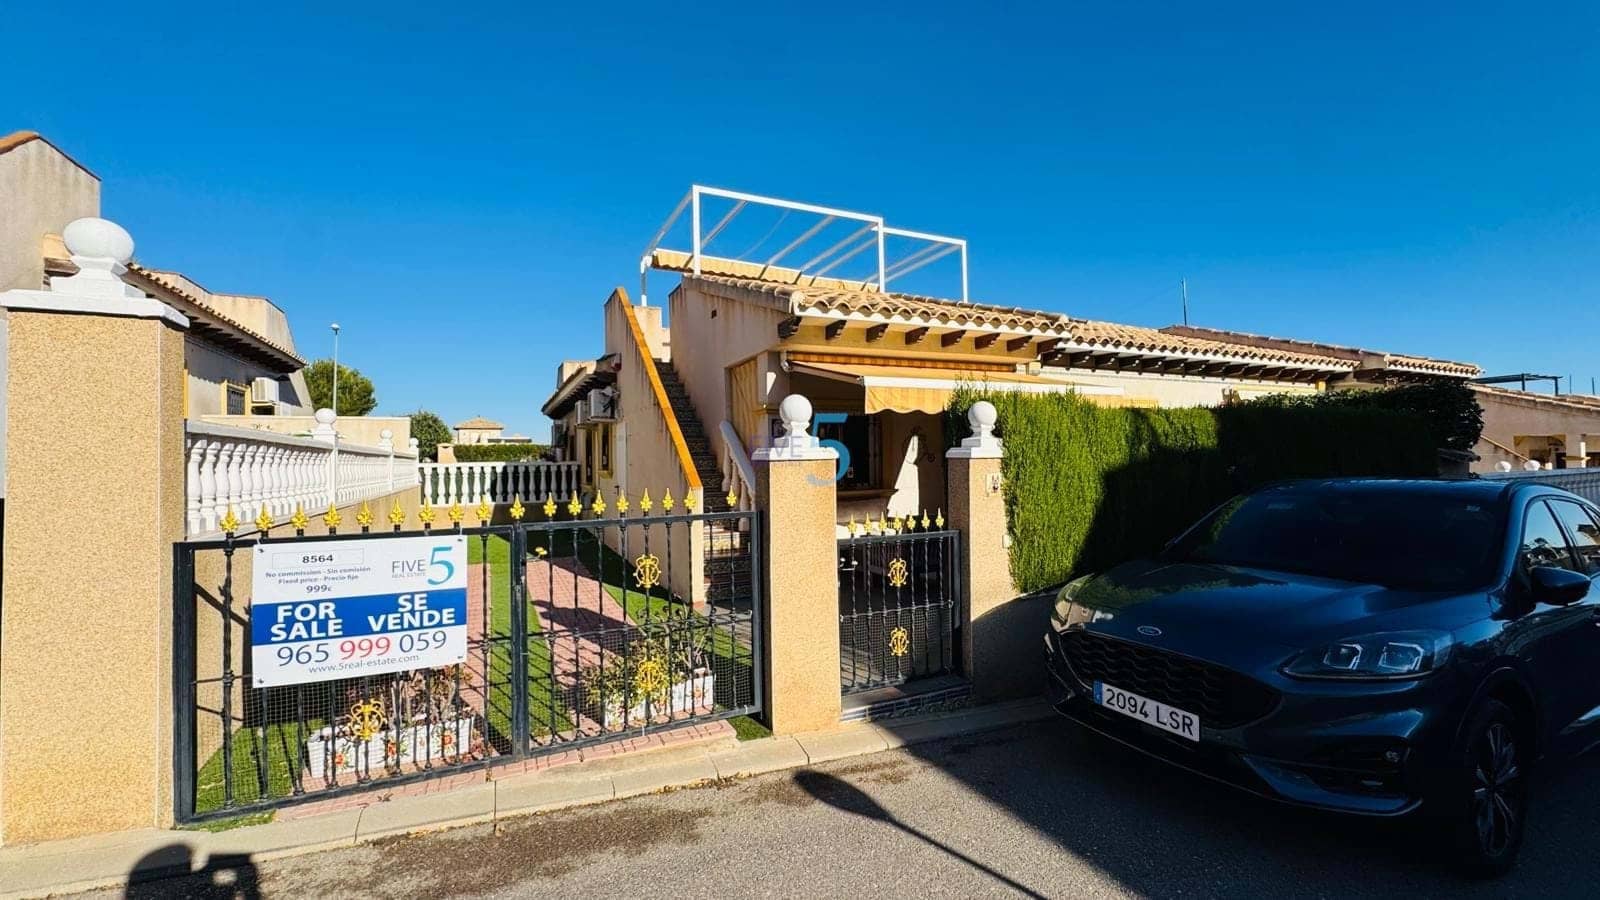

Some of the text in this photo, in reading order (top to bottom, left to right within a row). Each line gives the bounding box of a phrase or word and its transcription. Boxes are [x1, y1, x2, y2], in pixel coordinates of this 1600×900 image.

[302, 554, 334, 564] 8564
[391, 546, 455, 586] FIVE 5
[277, 602, 336, 624] FOR
[397, 593, 429, 613] SE
[270, 618, 344, 642] SALE
[367, 608, 456, 633] VENDE
[277, 630, 447, 667] 965 999 059
[308, 654, 421, 674] www.5real-estate.com
[1106, 688, 1193, 736] 2094 LSR
